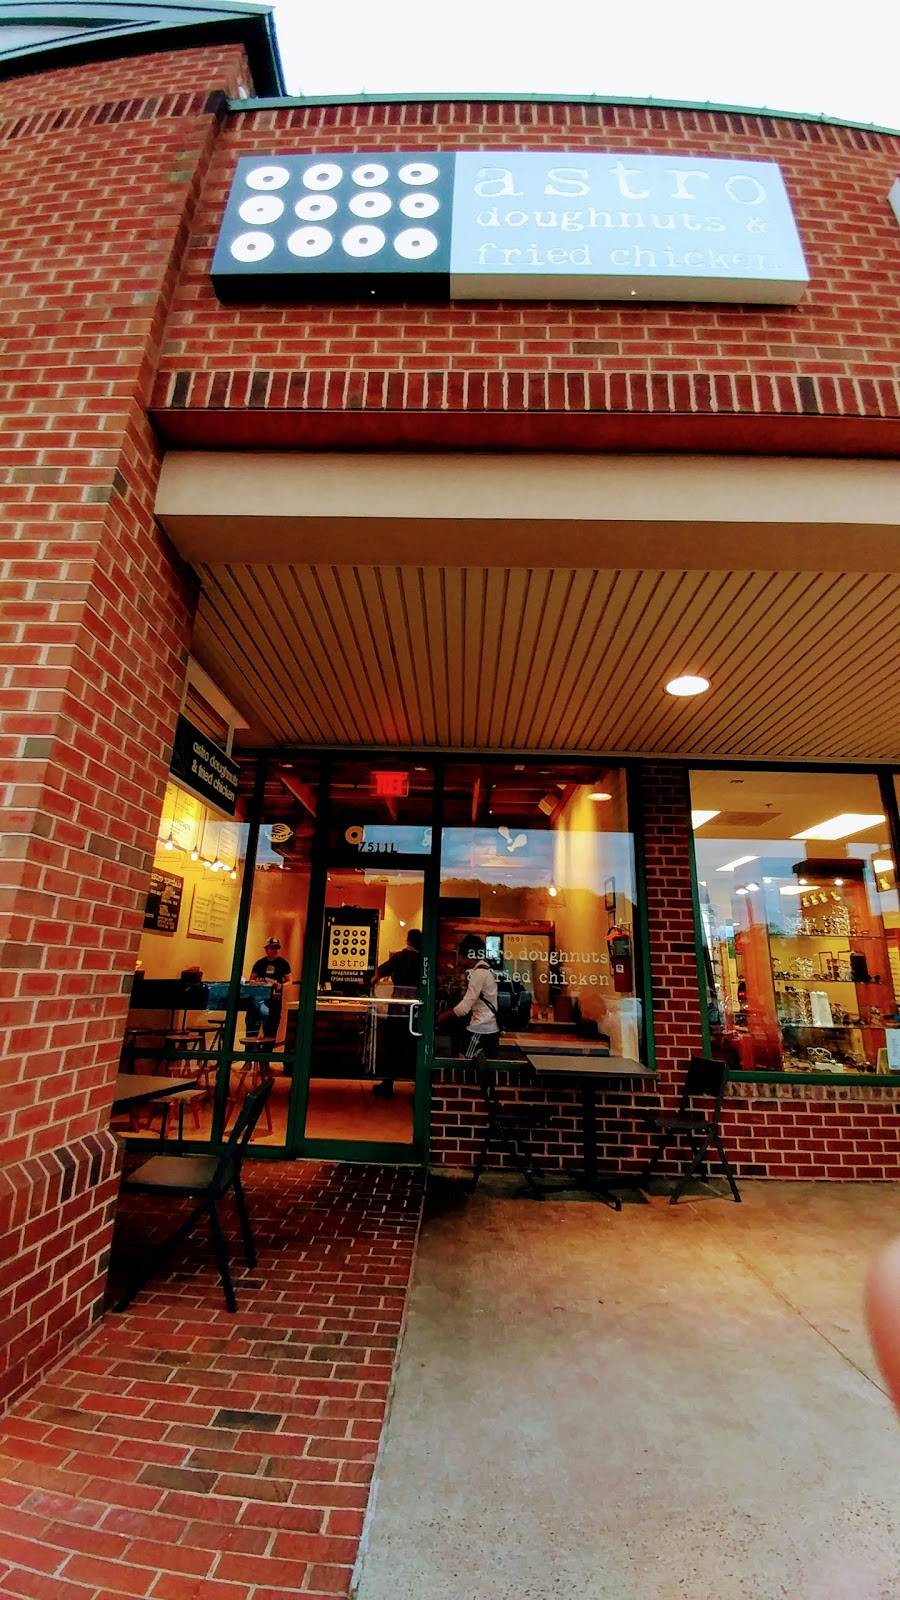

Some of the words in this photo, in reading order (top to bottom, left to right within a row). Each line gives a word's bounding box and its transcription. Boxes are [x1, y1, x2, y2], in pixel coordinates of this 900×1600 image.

[474, 161, 767, 205] astro
[476, 207, 727, 232] doughnuts
[745, 216, 768, 233] &
[476, 242, 593, 266] fried
[609, 244, 782, 270] chicken
[198, 764, 214, 785] fried
[213, 778, 235, 802] chicken
[332, 959, 365, 968] astro
[467, 948, 512, 960] astro
[519, 948, 609, 964] doughnuts
[539, 970, 609, 986] chicken
